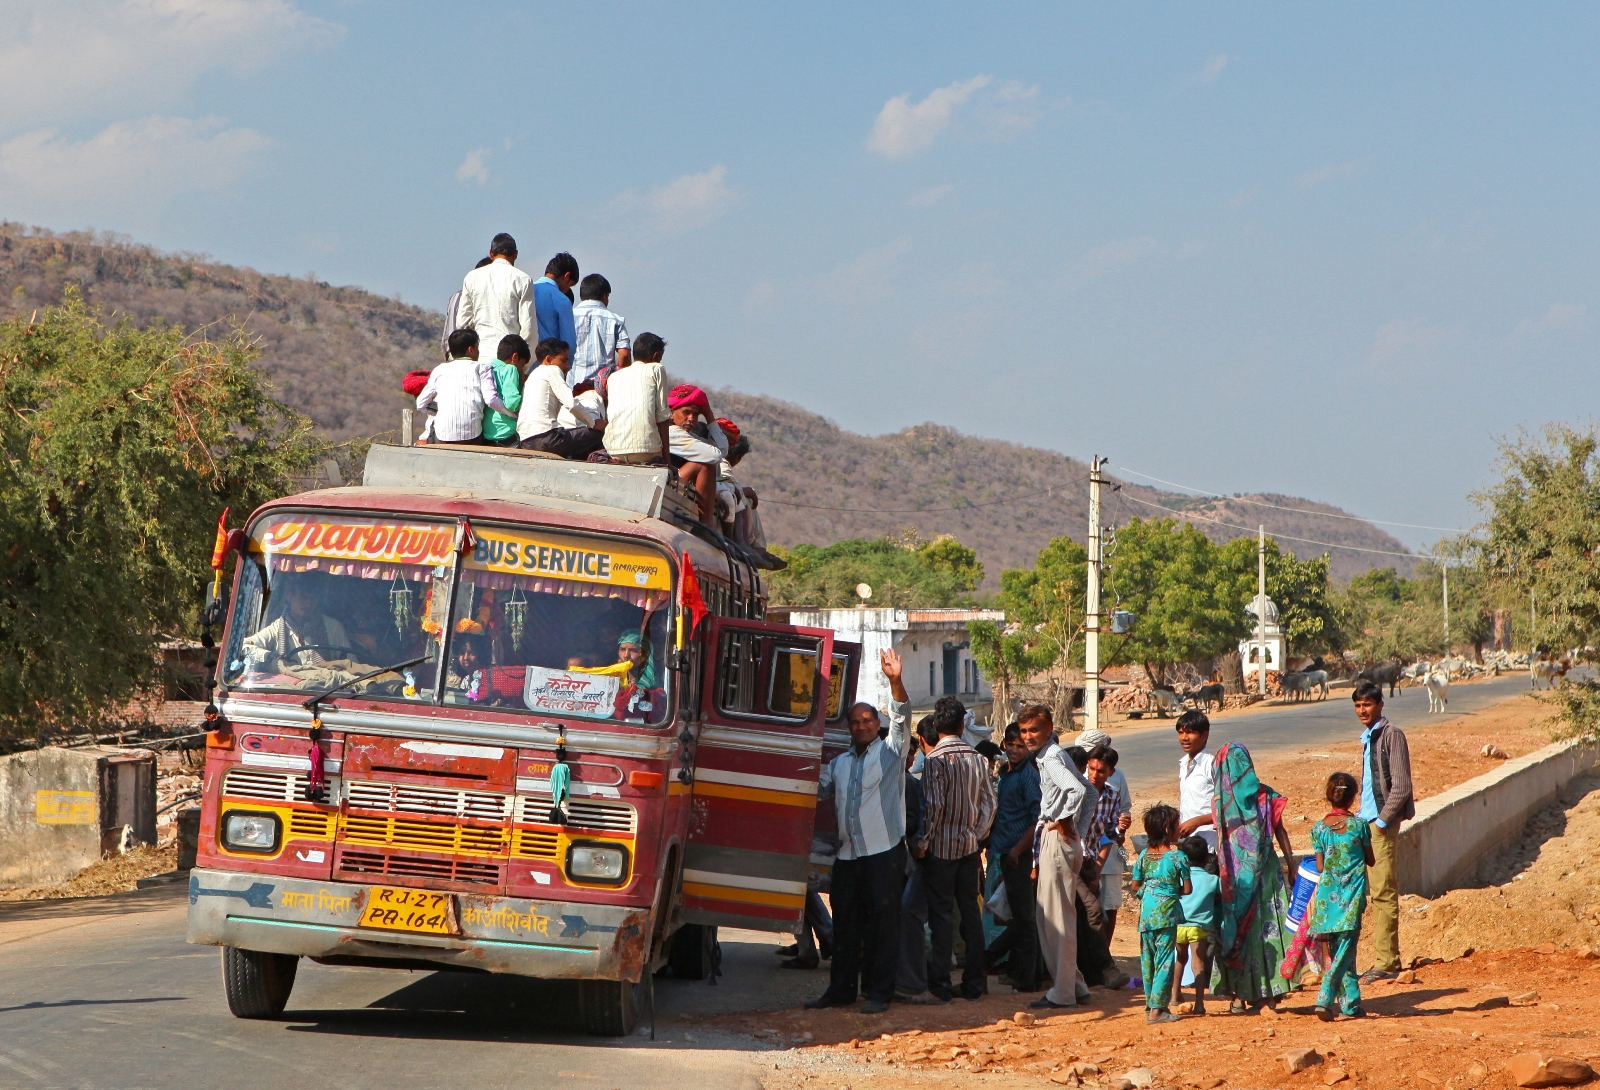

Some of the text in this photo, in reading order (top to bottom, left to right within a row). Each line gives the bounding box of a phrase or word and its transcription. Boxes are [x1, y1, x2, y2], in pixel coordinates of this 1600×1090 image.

[264, 517, 658, 580] Charbhuja BUS SERVICE AMARPURA
[316, 888, 351, 918] पिता
